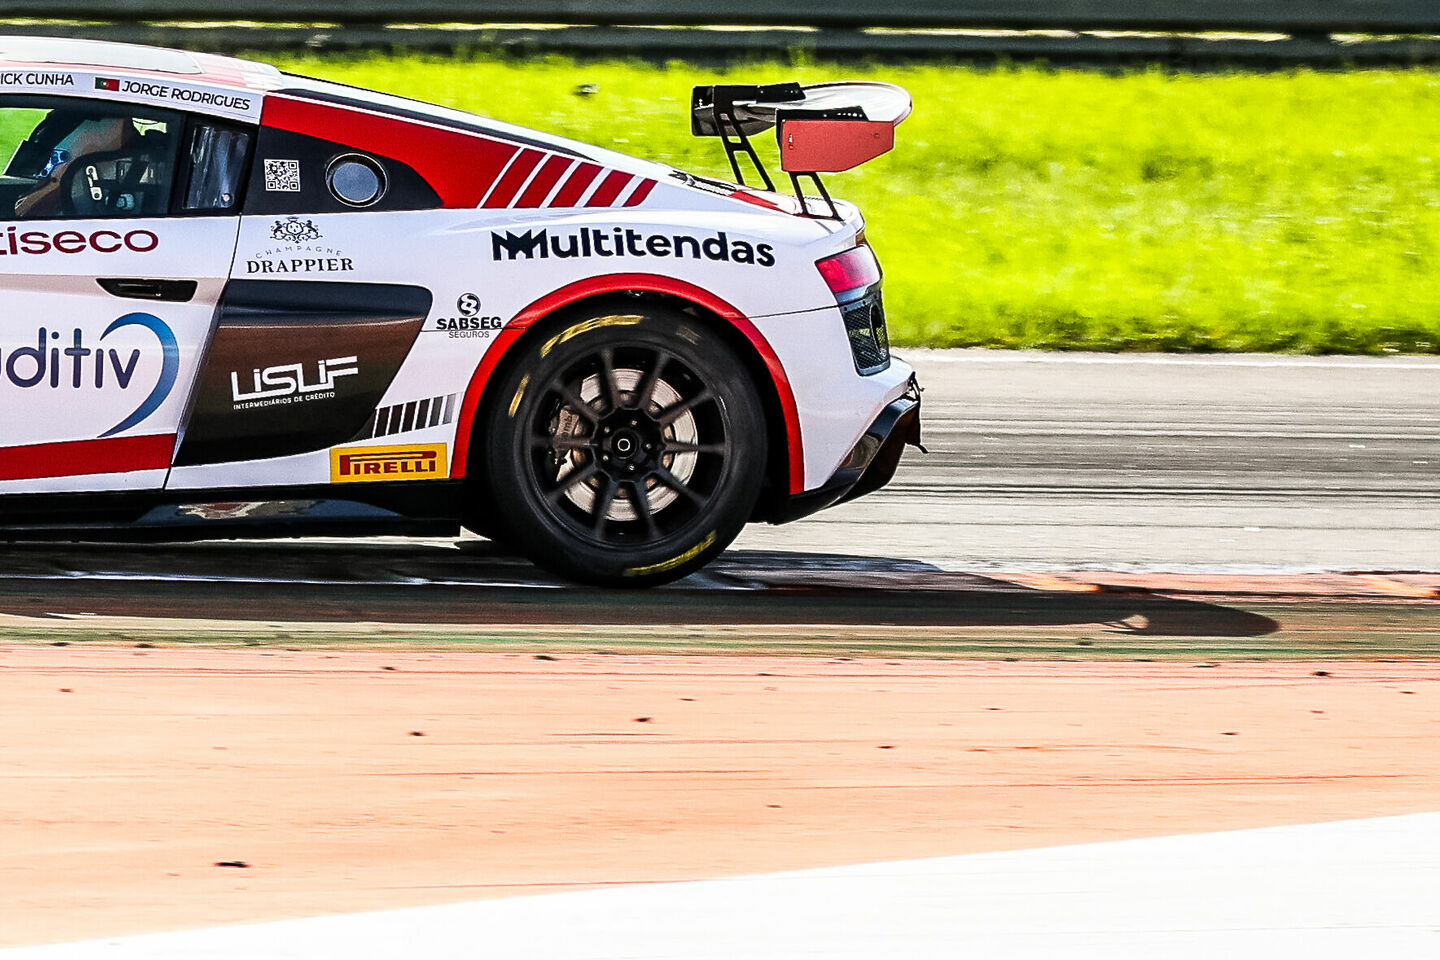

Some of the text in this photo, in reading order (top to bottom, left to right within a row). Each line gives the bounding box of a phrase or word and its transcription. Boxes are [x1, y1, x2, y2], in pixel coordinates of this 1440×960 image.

[25, 73, 75, 86] CUNHA
[121, 80, 251, 111] JORGE RODRIGUES
[255, 245, 343, 259] CHAMPAGNE
[491, 227, 776, 267] Multitendas
[246, 258, 355, 274] DRAPPIER
[435, 316, 502, 330] SABSEG
[448, 330, 490, 338] SEGUROS
[233, 397, 292, 410] INTERMEDIÁRIOS
[293, 395, 303, 403] DE
[339, 450, 437, 476] PIRELLI
